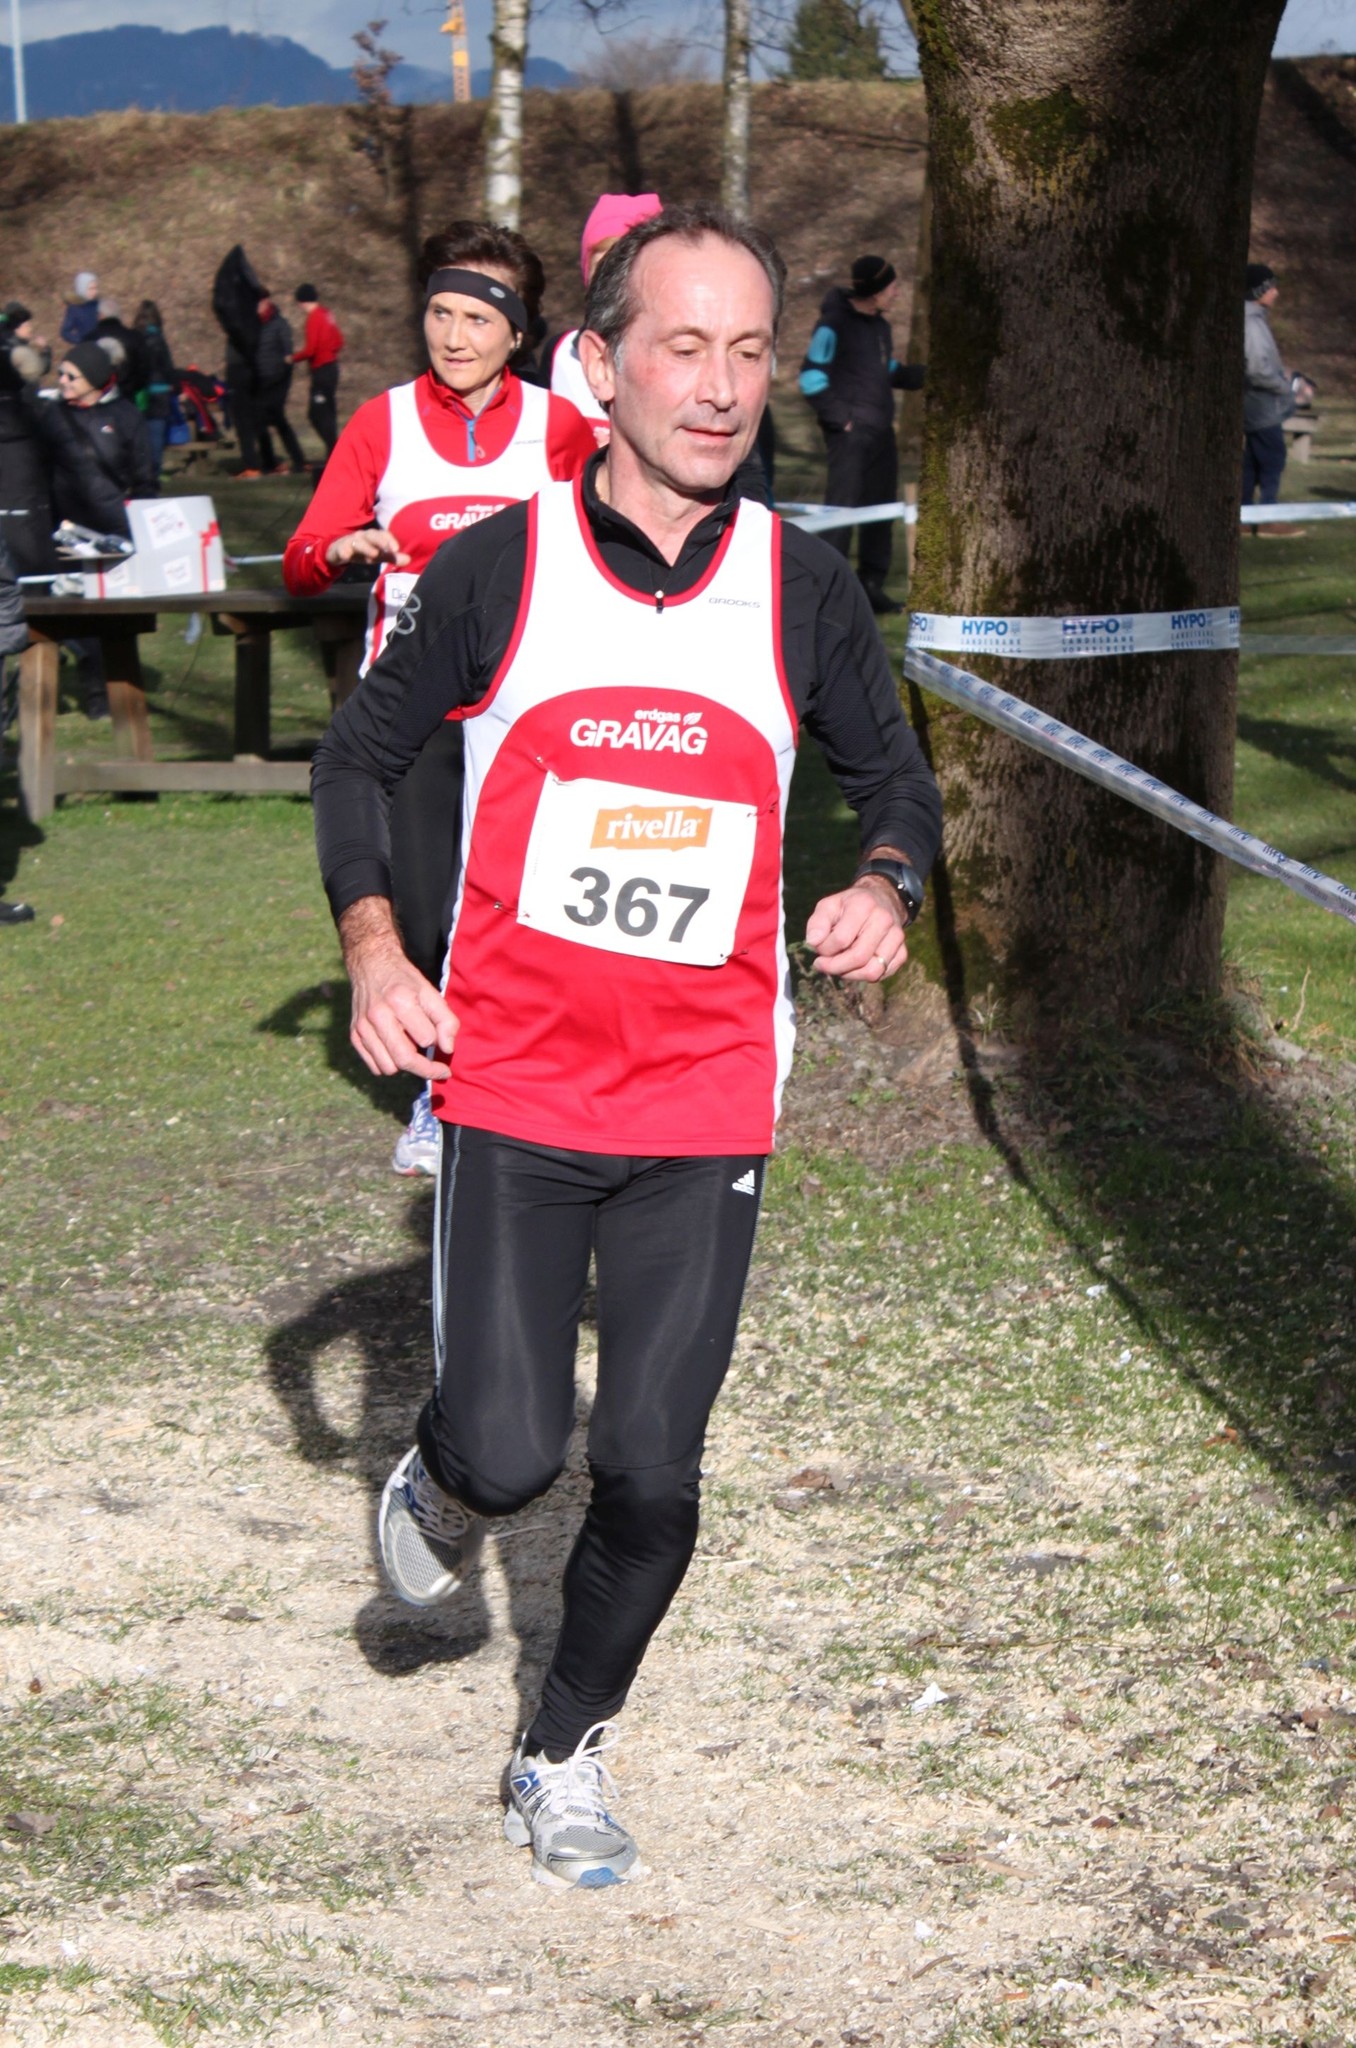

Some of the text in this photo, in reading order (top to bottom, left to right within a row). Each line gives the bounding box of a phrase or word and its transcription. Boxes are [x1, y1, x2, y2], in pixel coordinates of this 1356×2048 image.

[430, 512, 494, 530] GRAV
[911, 615, 928, 632] PO
[962, 620, 1009, 636] HYPO
[1062, 618, 1120, 635] HYPO
[1171, 612, 1206, 629] HYPO
[634, 708, 682, 724] erdgas
[570, 718, 709, 755] GRAVAG
[606, 810, 698, 839] rivella
[563, 866, 711, 943] 367
